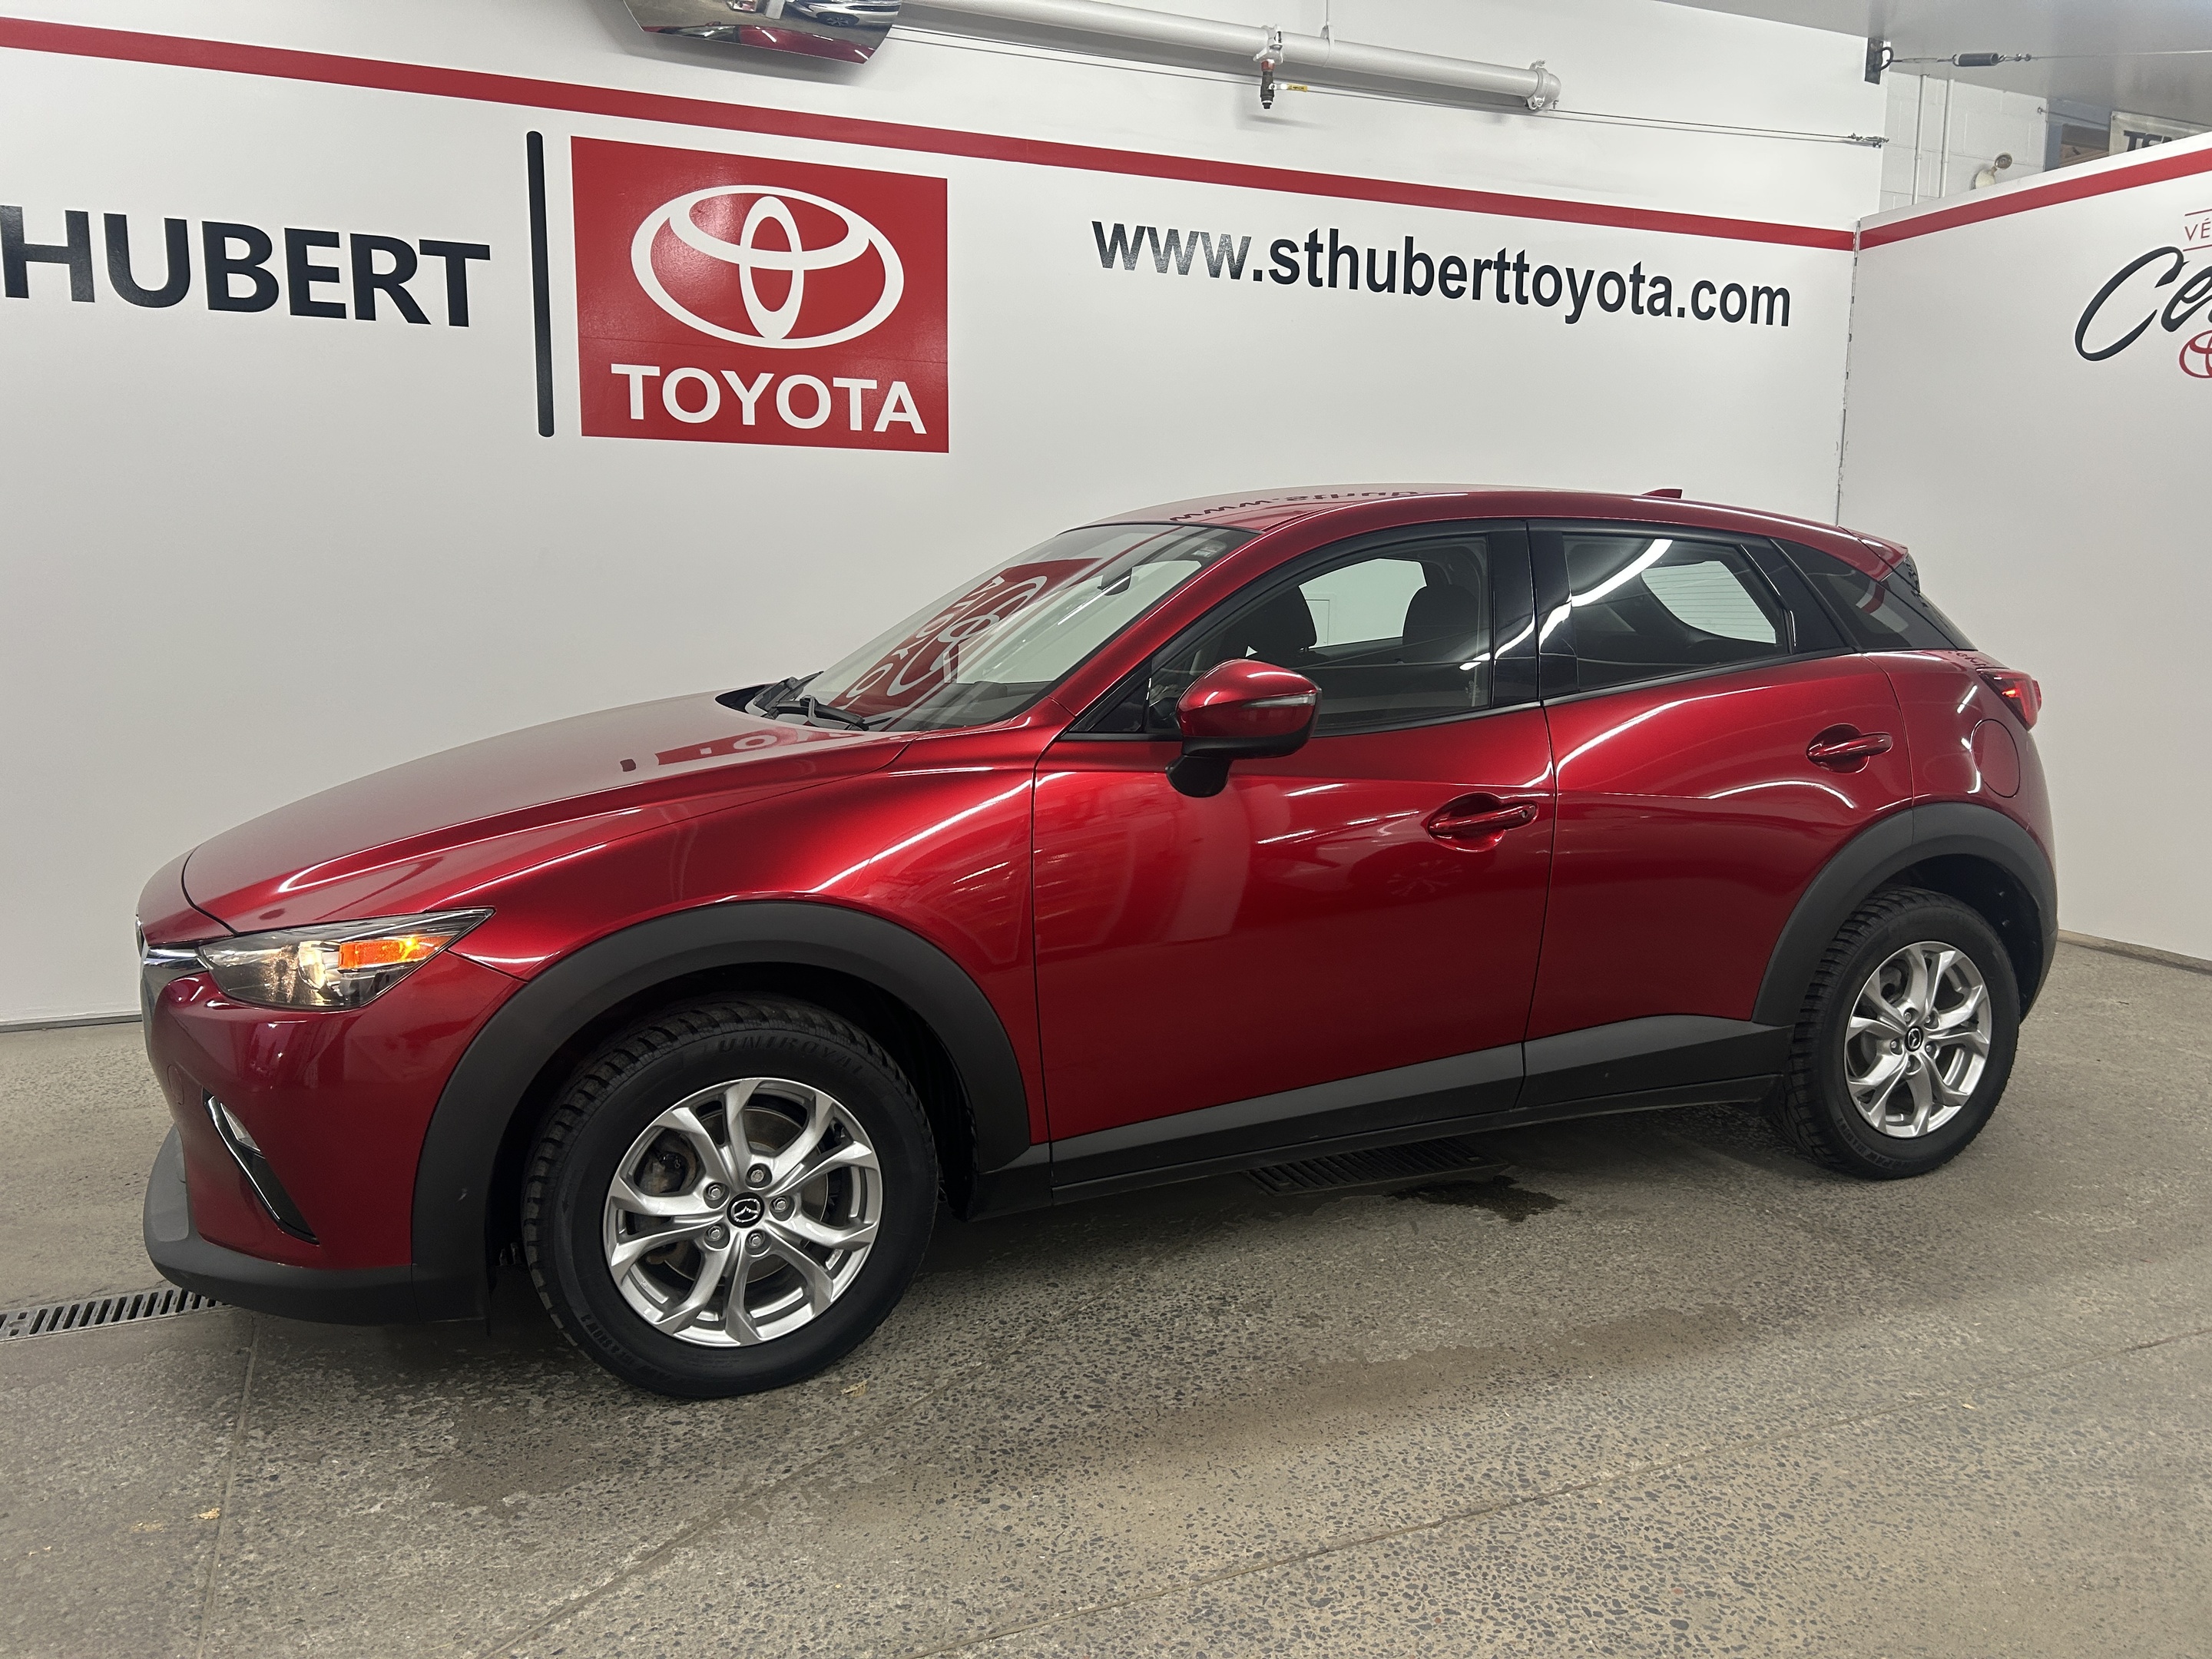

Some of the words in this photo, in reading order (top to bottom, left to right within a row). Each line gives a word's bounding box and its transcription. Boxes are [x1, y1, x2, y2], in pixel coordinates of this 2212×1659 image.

[0, 205, 491, 328] HUBERT
[1091, 220, 1791, 327] www.sthuberttoyota.com
[2075, 246, 2212, 362] Ce
[611, 363, 927, 435] TOYOTA
